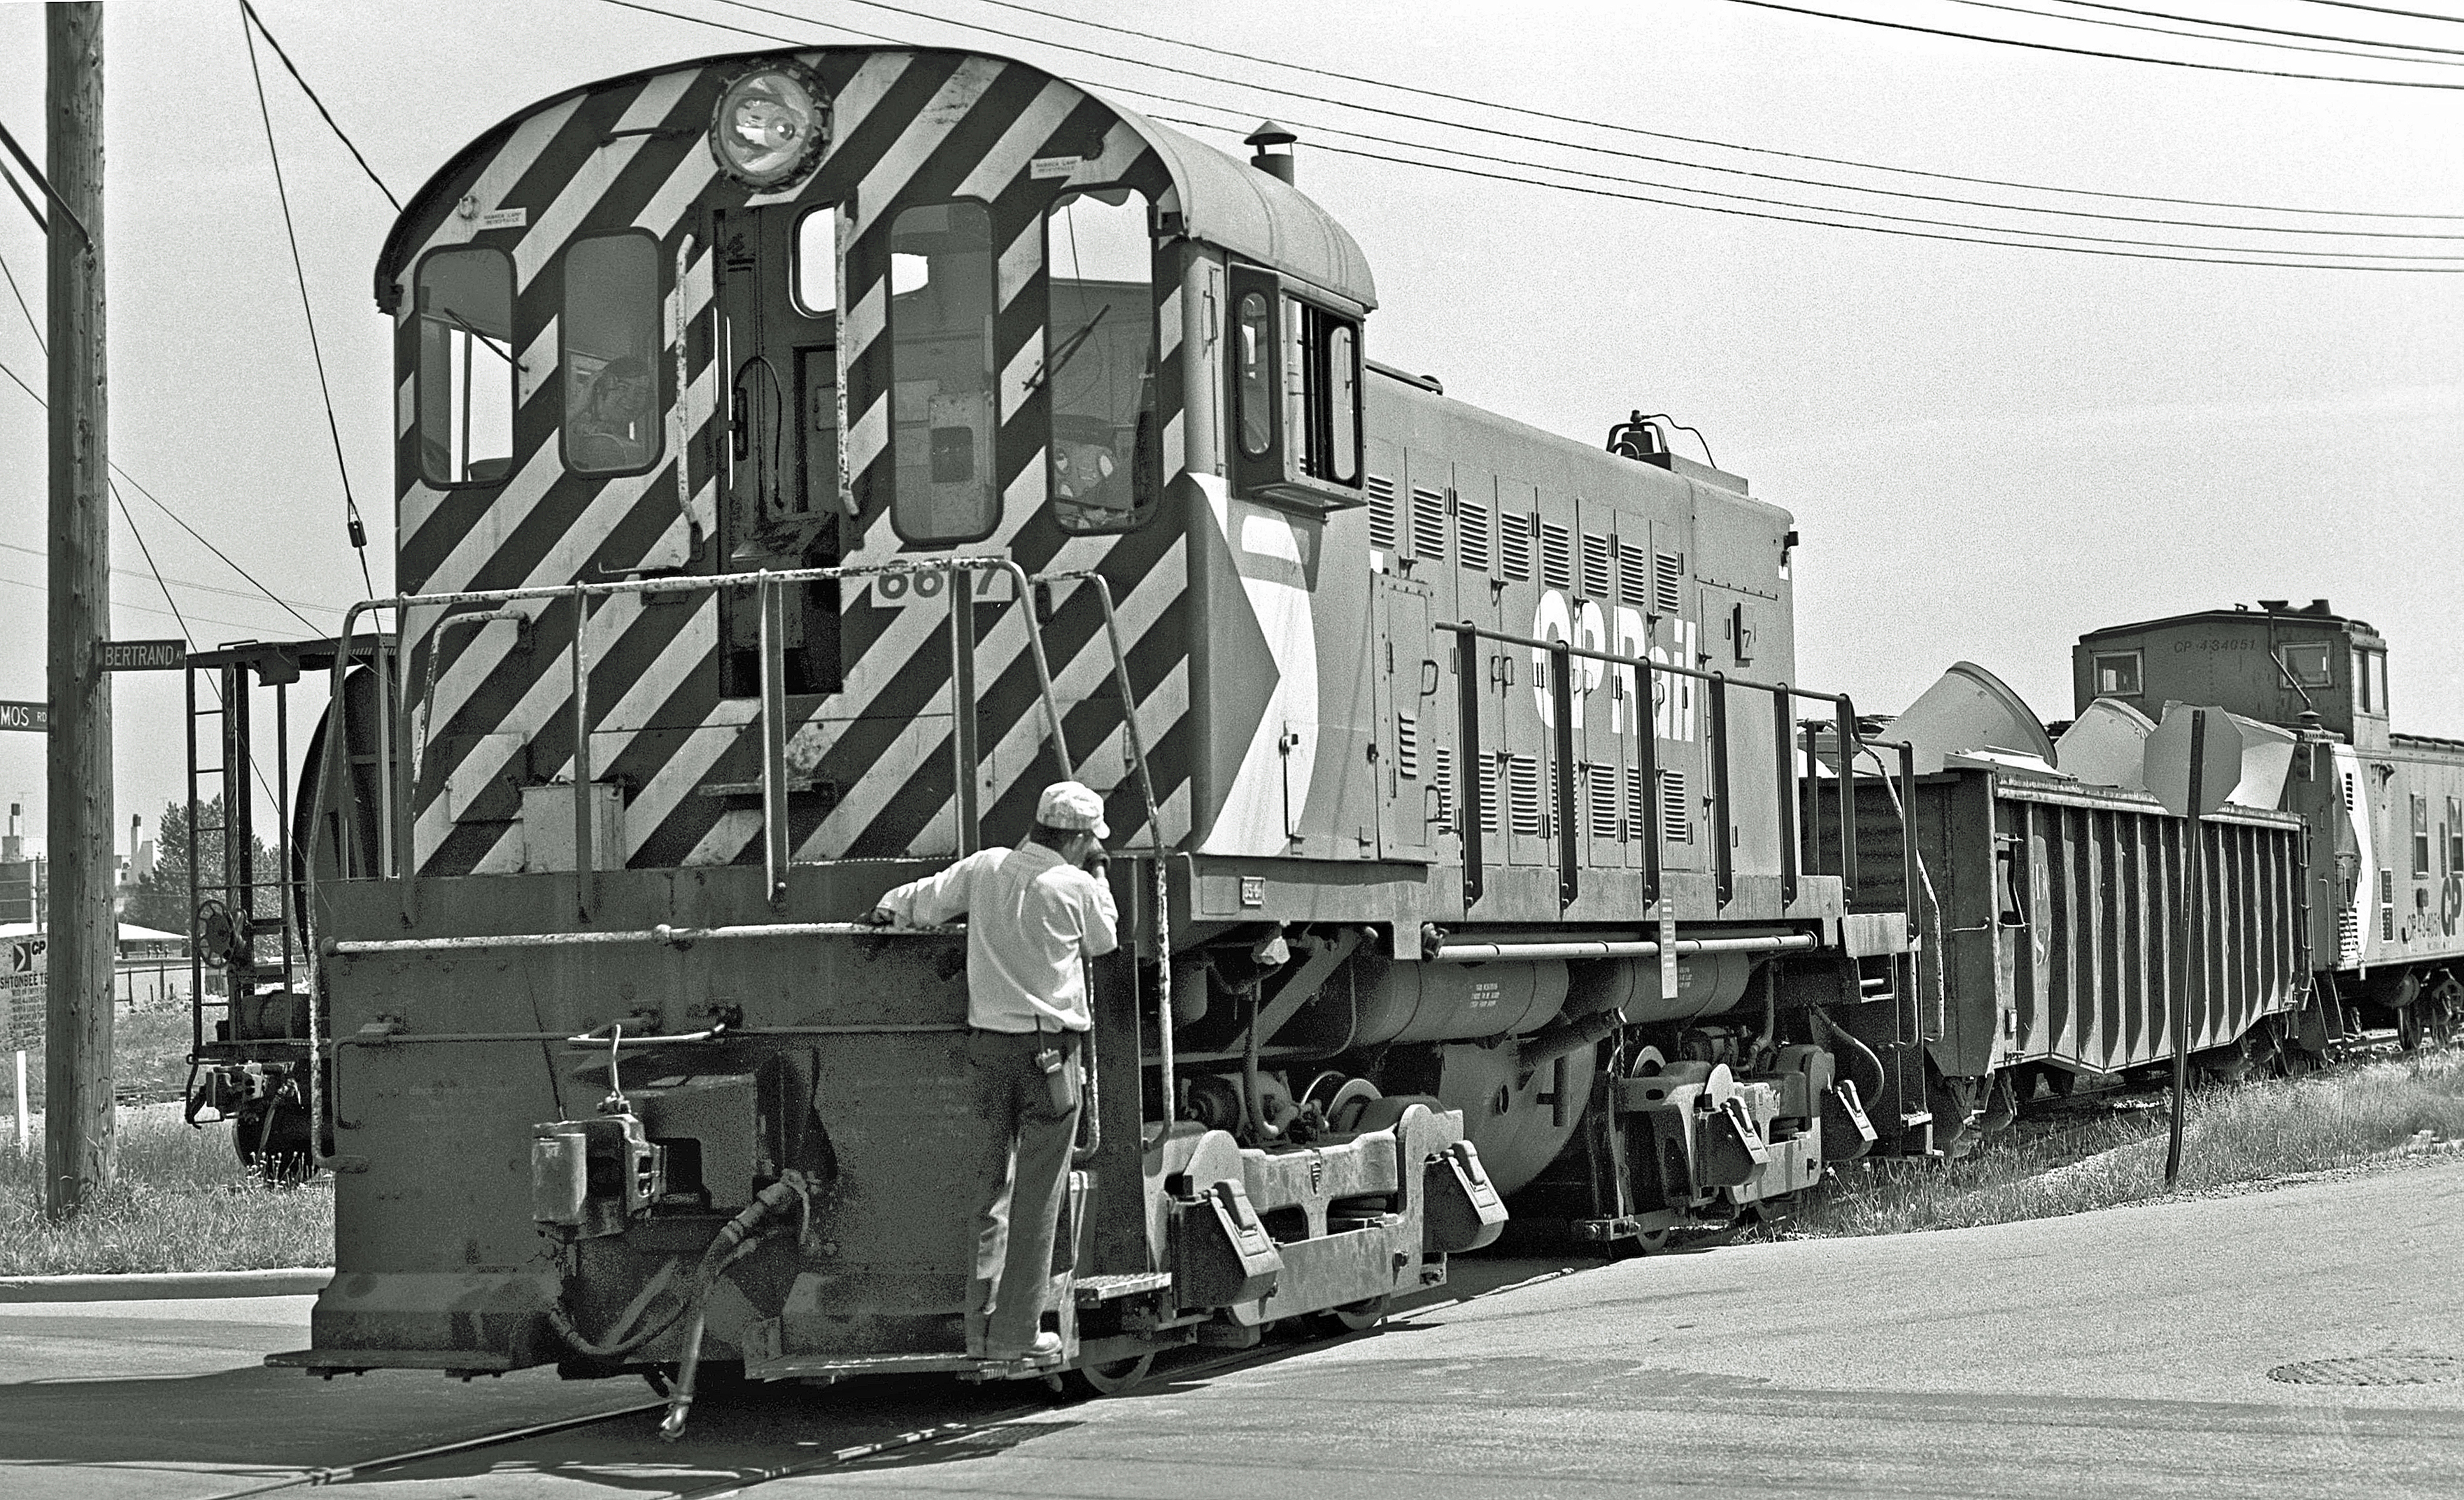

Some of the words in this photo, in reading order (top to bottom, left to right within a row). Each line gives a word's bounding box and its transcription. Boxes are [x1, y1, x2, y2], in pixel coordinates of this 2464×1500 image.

[104, 645, 174, 667] BERTRAND
[176, 650, 184, 661] AV
[1532, 590, 1606, 729] CP
[1611, 605, 1696, 742] Rail
[37, 711, 47, 723] RD
[2440, 877, 2462, 937] CP
[32, 940, 46, 955] CP
